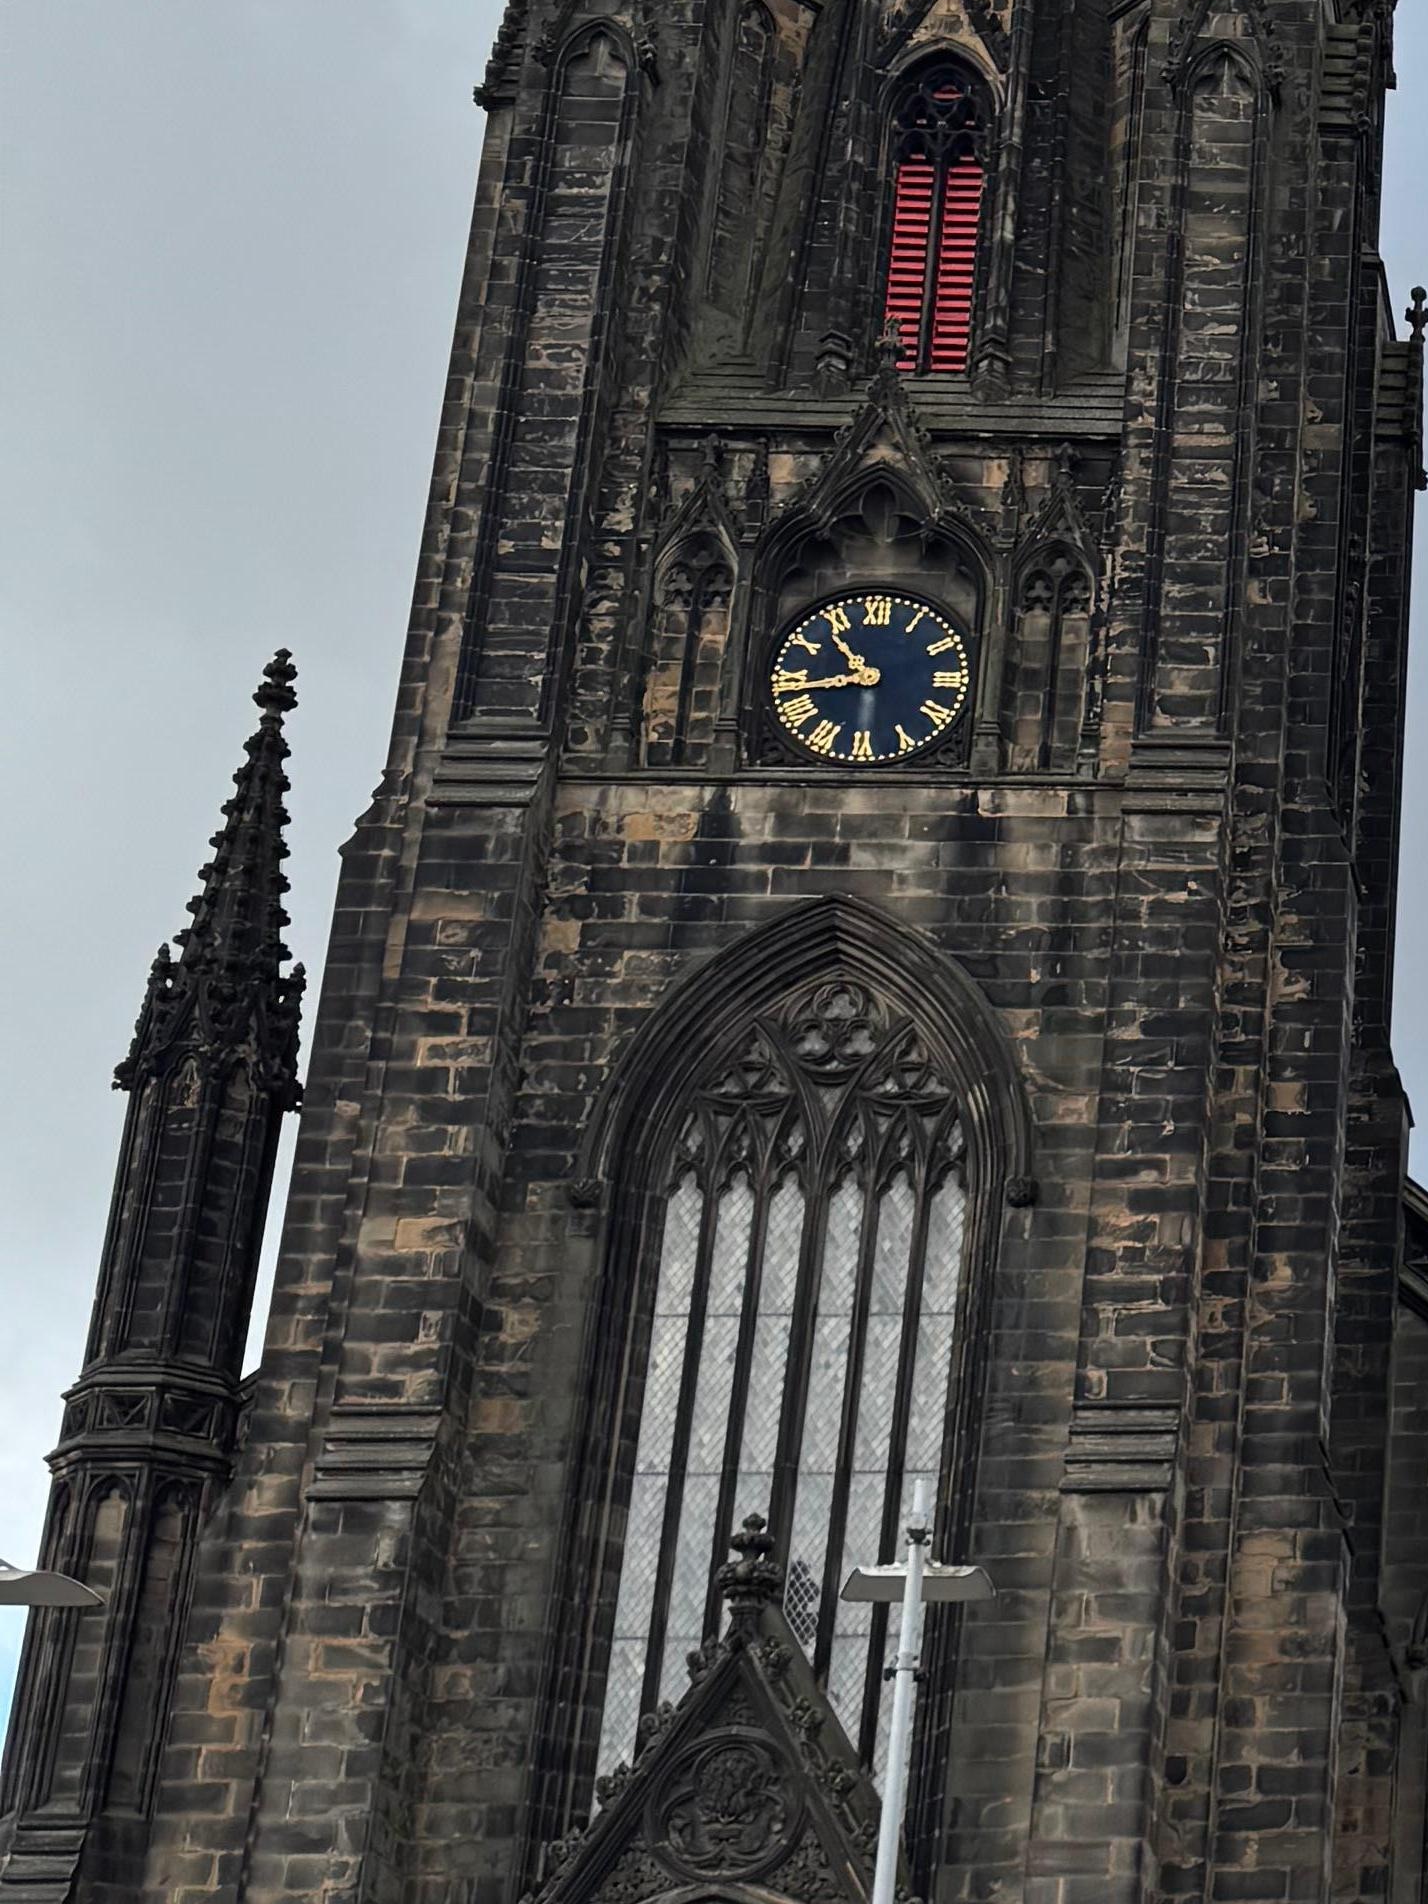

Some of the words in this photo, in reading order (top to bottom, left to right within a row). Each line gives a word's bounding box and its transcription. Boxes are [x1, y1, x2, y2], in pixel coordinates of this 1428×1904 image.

[823, 607, 851, 634] XI
[863, 601, 891, 625] XII
[905, 611, 924, 633] I
[792, 633, 821, 655] X
[926, 637, 955, 656] II
[932, 671, 962, 687] III
[783, 694, 819, 727] VIII
[809, 719, 841, 749] VII
[852, 731, 873, 755] VI
[895, 724, 916, 750] V
